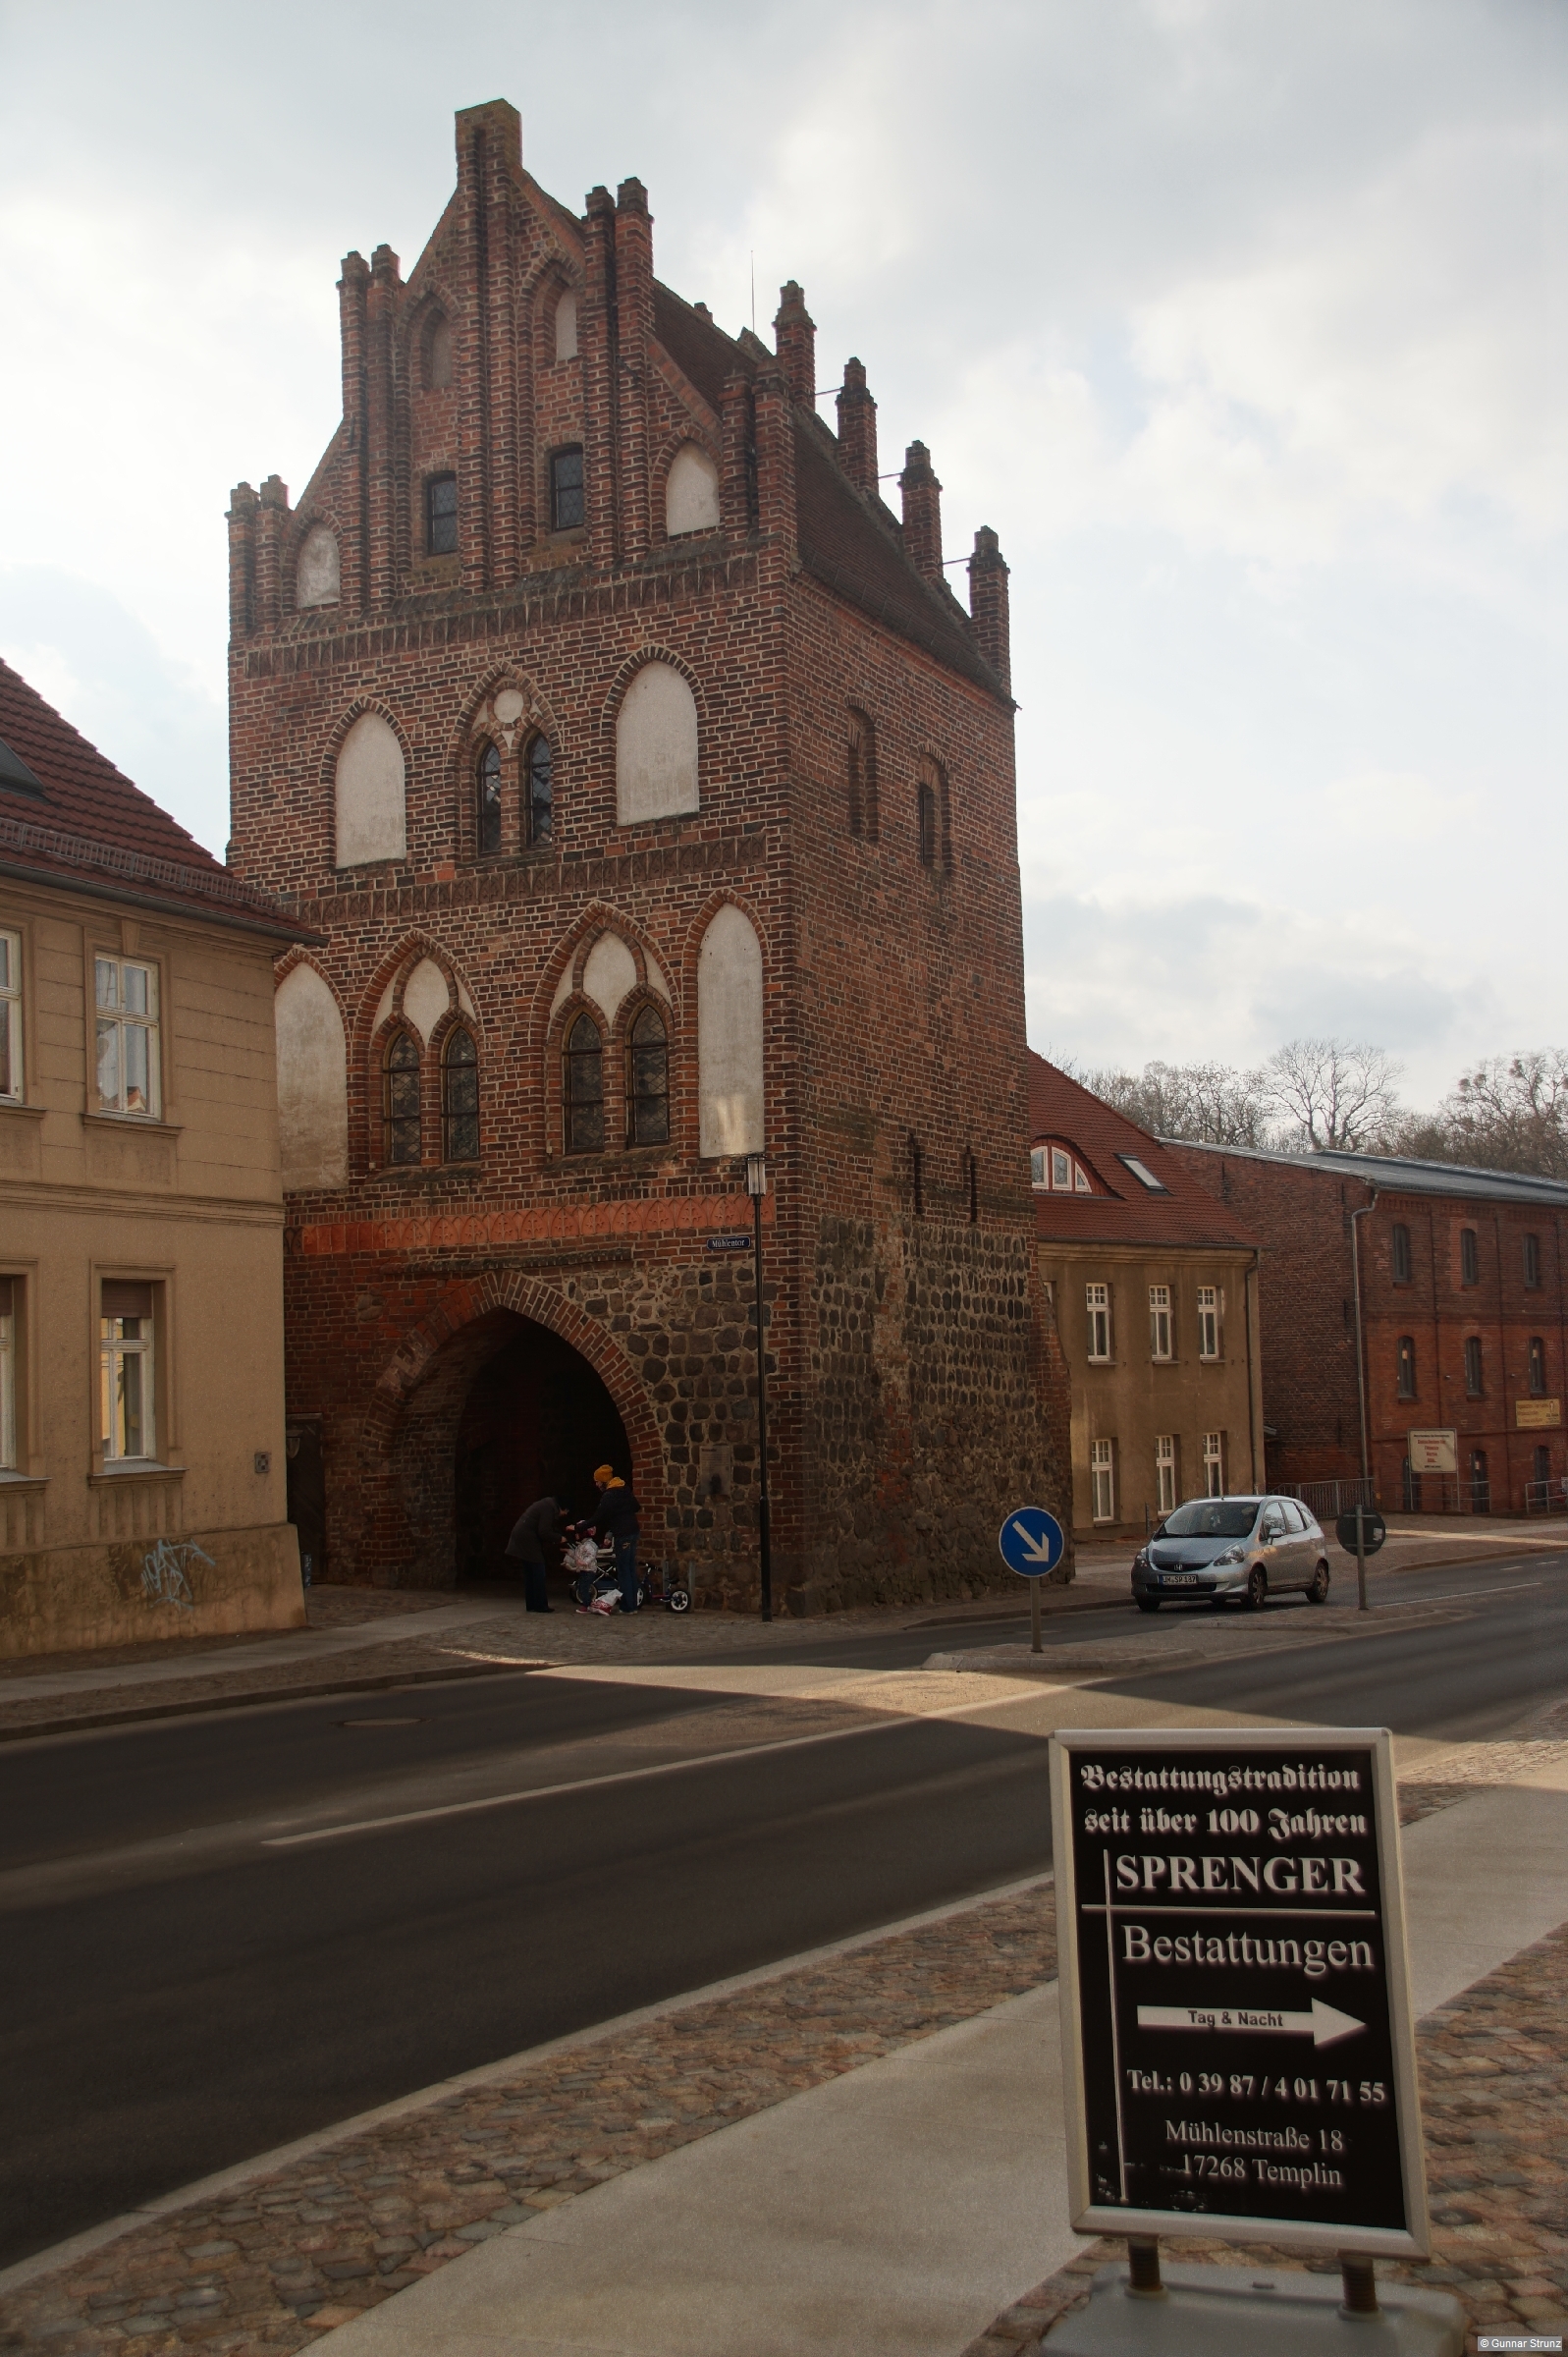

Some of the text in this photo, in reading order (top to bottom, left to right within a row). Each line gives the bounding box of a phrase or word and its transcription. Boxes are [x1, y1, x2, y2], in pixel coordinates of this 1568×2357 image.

[712, 1239, 745, 1248] Mühlentor
[1080, 1764, 1360, 1796] Bestattungstradition
[1084, 1807, 1368, 1839] seit über 100 Jahren
[1116, 1854, 1366, 1893] SPRENGER
[1122, 1925, 1375, 1976] Bestattungen
[1188, 2009, 1283, 2027] Tag & Nacht
[1127, 2069, 1385, 2102] Tel.: 0 39 87 / 4 01 71 55
[1165, 2119, 1343, 2151] Mühlenstraße 18
[1181, 2154, 1342, 2189] 17268 Templin
